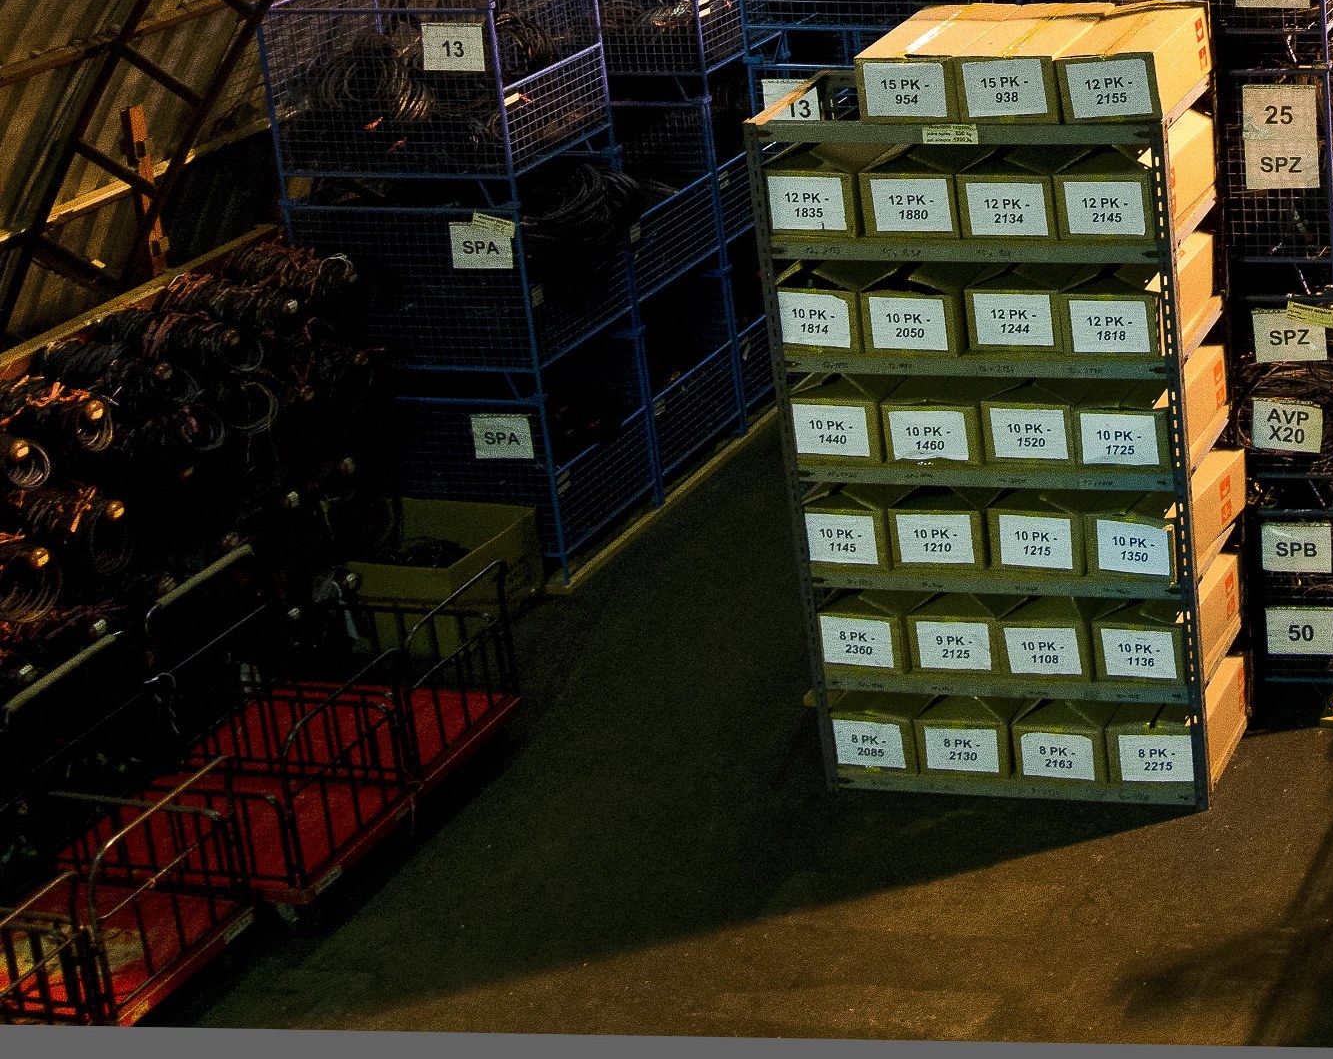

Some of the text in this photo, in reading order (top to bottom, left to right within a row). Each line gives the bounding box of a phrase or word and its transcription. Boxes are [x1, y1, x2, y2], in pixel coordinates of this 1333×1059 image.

[442, 40, 464, 57] 13
[881, 79, 897, 90] 15
[980, 77, 997, 89] 15
[1085, 79, 1101, 90] 12
[895, 94, 918, 105] 954
[995, 91, 1019, 103] 938
[1096, 92, 1127, 105] 2155
[1265, 106, 1293, 124] 25
[1261, 157, 1302, 172] SPZ
[785, 192, 799, 203] 12
[888, 195, 903, 206] 12
[1082, 197, 1097, 209] 12
[984, 198, 998, 209] 12
[795, 207, 824, 218] 1835
[899, 209, 929, 220] 1880
[1092, 212, 1122, 223] 2145
[994, 213, 1024, 224] 2134
[462, 241, 499, 255] SPA
[792, 308, 805, 319] 10
[886, 313, 900, 323] 10
[991, 309, 1005, 320] 12
[1087, 316, 1101, 327] 12
[801, 323, 828, 334] 1814
[896, 327, 925, 339] 2050
[1001, 323, 1030, 334] 1244
[1097, 330, 1126, 341] 1818
[1270, 330, 1310, 346] SPZ
[1268, 409, 1309, 426] AVP
[809, 419, 823, 430] 10
[1007, 423, 1021, 434] 10
[906, 426, 920, 437] 10
[1096, 430, 1111, 441] 10
[1270, 426, 1305, 444] X20
[484, 432, 519, 445] SPA
[819, 434, 847, 445] 1440
[1017, 437, 1046, 448] 1520
[916, 440, 945, 451] 1460
[1106, 445, 1135, 456] 1725
[819, 528, 833, 539] 10
[914, 529, 928, 539] 10
[1015, 530, 1029, 541] 10
[1112, 536, 1126, 547] 10
[829, 542, 857, 553] 1145
[924, 542, 952, 553] 1210
[1024, 545, 1051, 557] 1215
[1276, 542, 1317, 557] SPB
[1121, 550, 1149, 563] 1350
[1289, 625, 1314, 642] 50
[936, 635, 944, 645] 9
[1021, 641, 1035, 651] 10
[1118, 643, 1132, 653] 10
[942, 648, 970, 659] 2125
[1031, 654, 1059, 664] 1108
[1127, 657, 1155, 667] 1136
